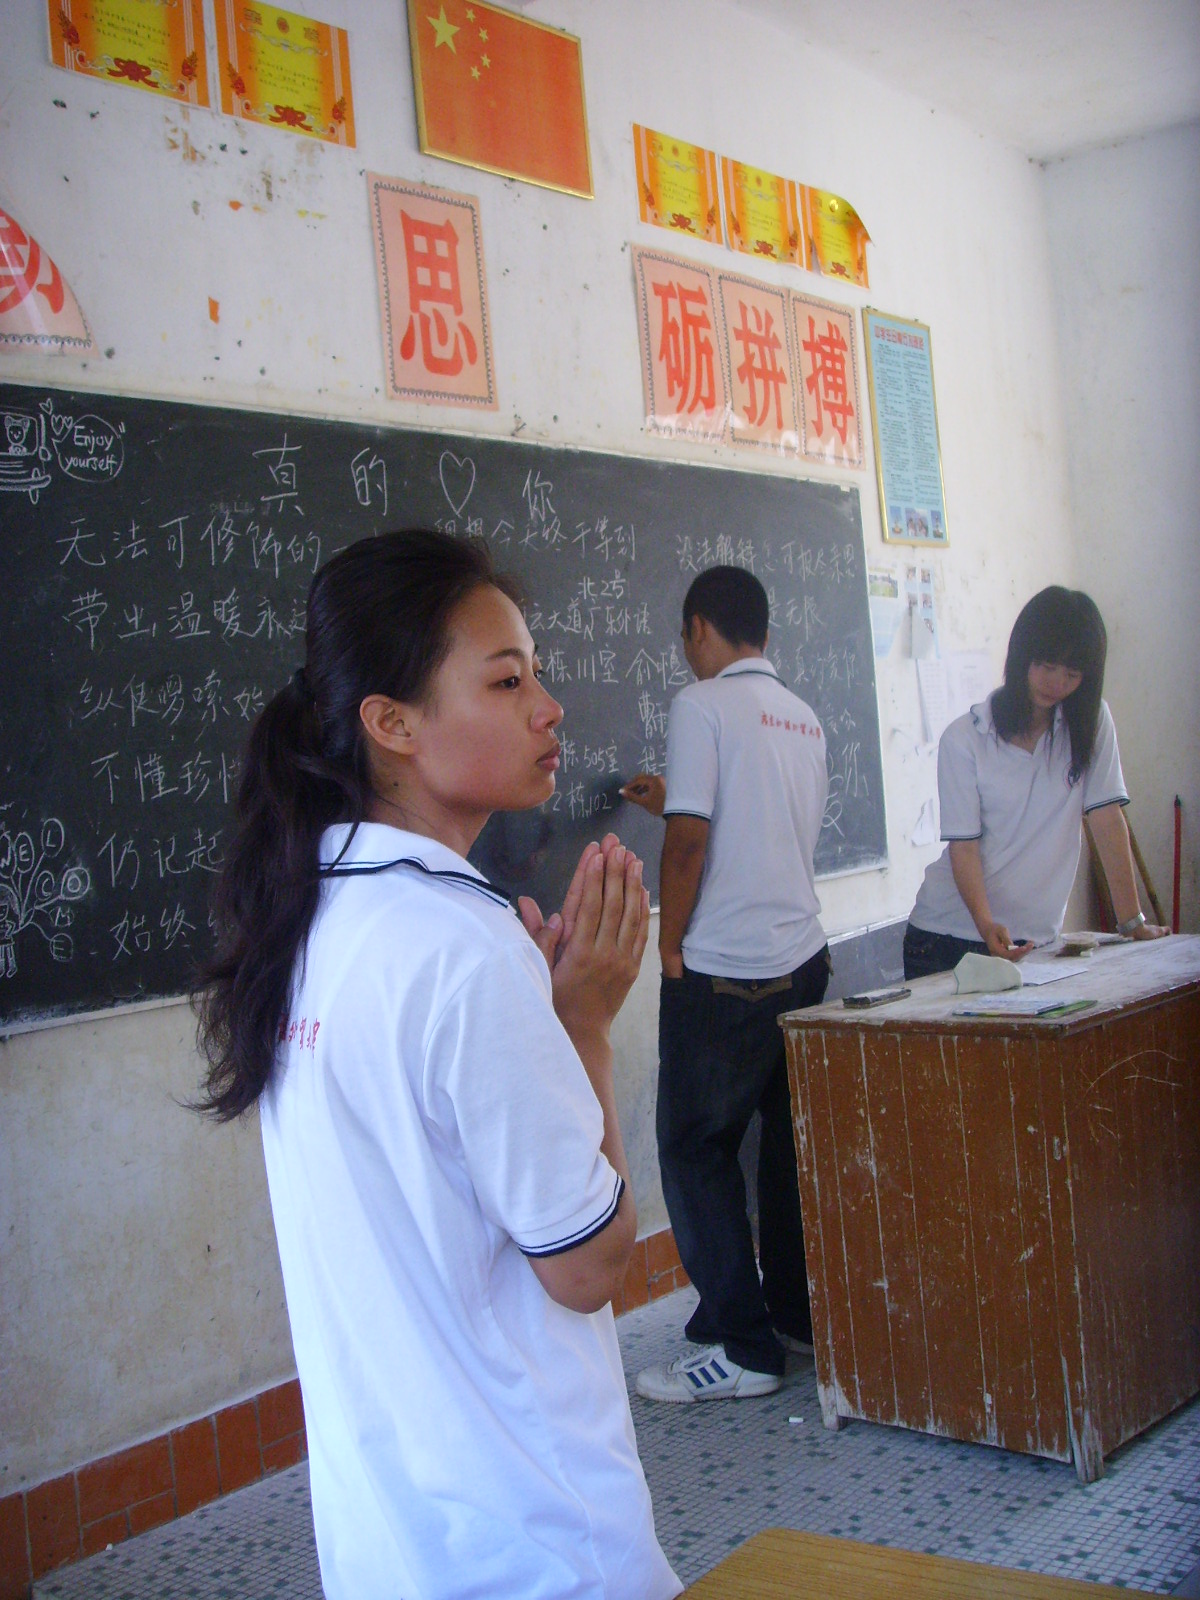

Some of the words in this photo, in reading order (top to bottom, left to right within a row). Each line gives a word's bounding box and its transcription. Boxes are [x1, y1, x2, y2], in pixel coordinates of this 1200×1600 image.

[400, 208, 478, 377] 思
[73, 424, 114, 454] Enjoy
[64, 455, 118, 476] yourself
